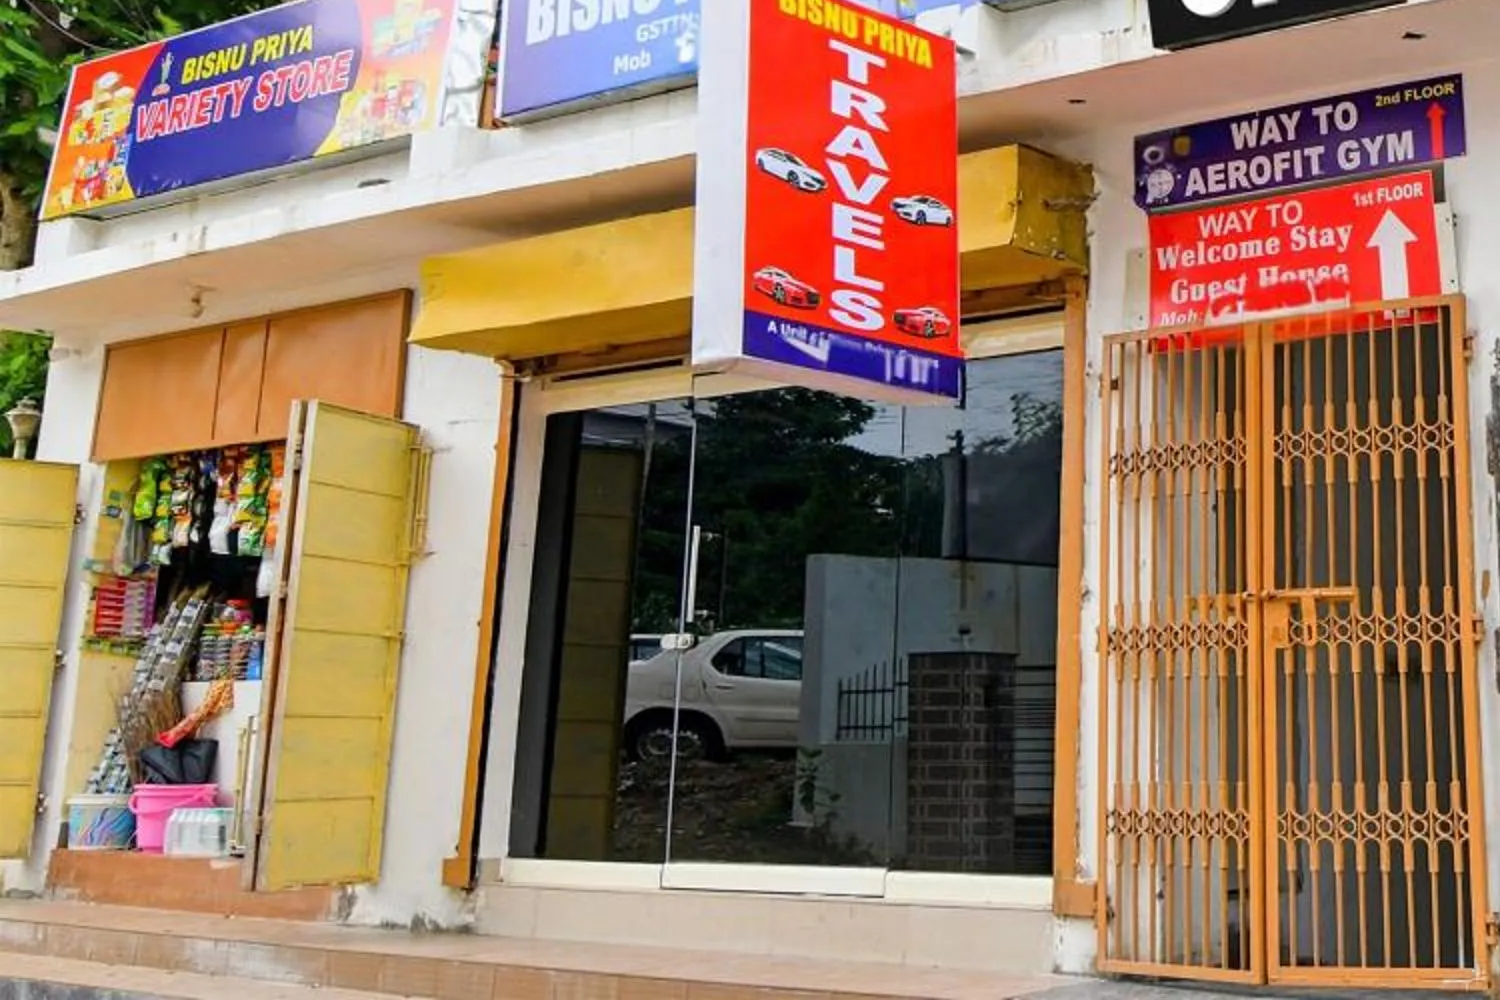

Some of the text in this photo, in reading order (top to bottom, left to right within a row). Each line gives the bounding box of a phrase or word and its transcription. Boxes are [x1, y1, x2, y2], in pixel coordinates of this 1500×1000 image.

[181, 23, 315, 86] BISNU PRIYA
[612, 48, 652, 76] Mob
[862, 13, 933, 70] PRIYA
[134, 49, 355, 143] VARIETY STORE
[1375, 82, 1456, 107] 2nd FLOOR
[1229, 101, 1359, 151] WAY TO
[824, 38, 889, 333] TRAVELS
[1184, 130, 1415, 197] AEROFIT GYM
[1353, 182, 1424, 207] 1st FLOOR
[1198, 200, 1303, 240] WAY TO
[1156, 223, 1353, 271] Welcome Stay
